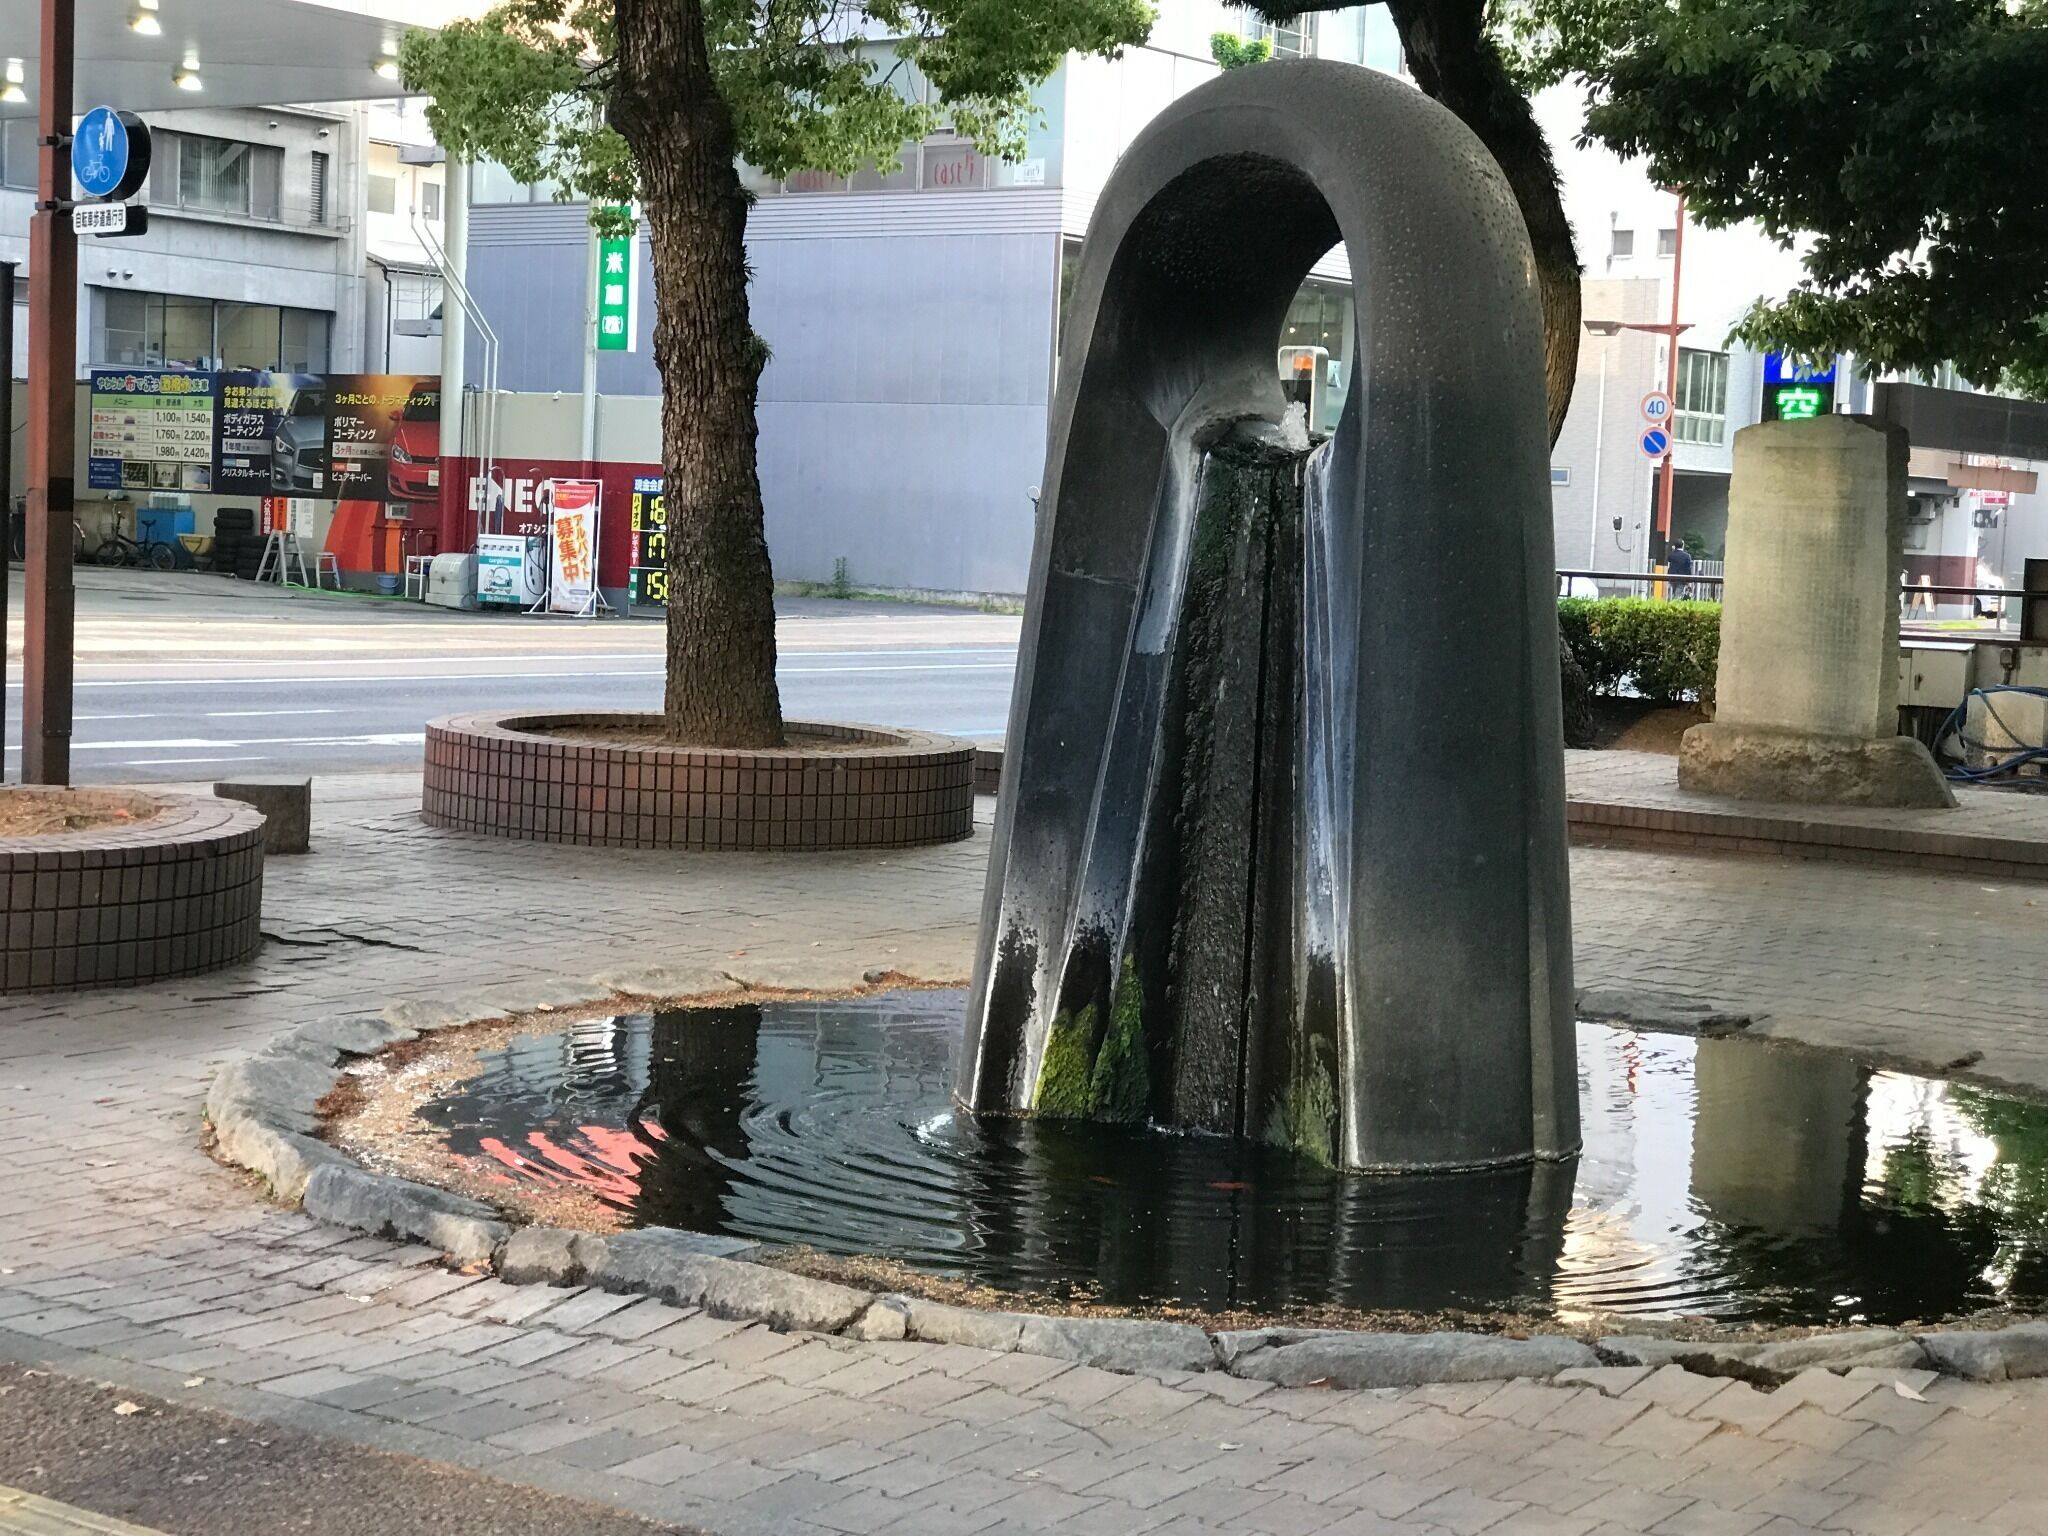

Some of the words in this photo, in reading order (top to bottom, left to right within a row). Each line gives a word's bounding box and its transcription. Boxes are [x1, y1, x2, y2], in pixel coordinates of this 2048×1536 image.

[76, 209, 124, 228] 自転車歩道通行可
[113, 398, 134, 406] メニュー
[1647, 400, 1665, 415] 40
[223, 413, 265, 425] ボディガラス
[223, 425, 264, 437] コーティング
[333, 428, 377, 440] コーティング
[632, 495, 641, 529] ハイオク
[555, 516, 579, 585] 募集中
[572, 513, 591, 580] アルバイト
